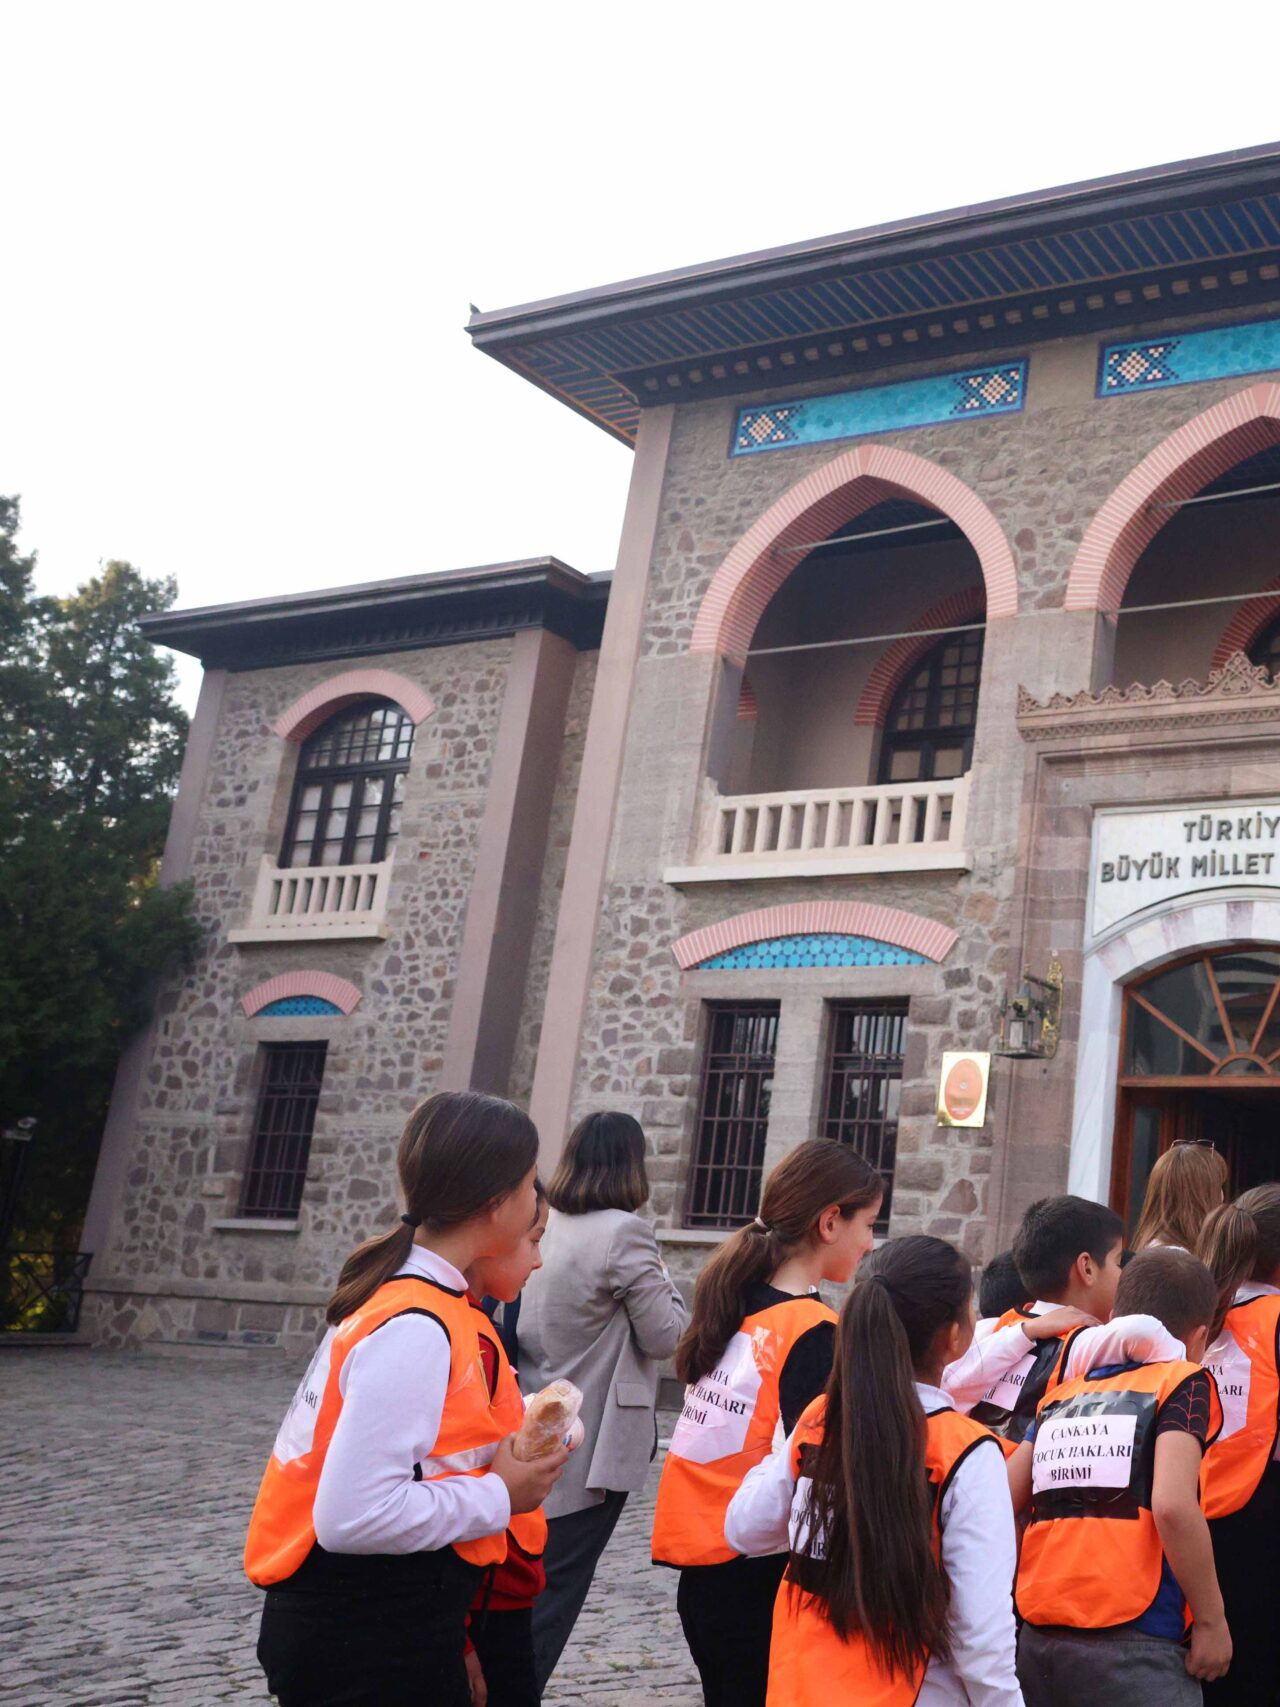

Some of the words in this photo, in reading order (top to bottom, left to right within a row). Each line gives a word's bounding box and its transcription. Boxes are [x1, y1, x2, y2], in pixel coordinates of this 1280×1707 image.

[1100, 853, 1179, 882] BÜYÜK
[1191, 849, 1274, 877] MİLLET
[682, 1403, 708, 1425] İRİMİ
[1051, 1423, 1109, 1441] ÇANKAYA
[1068, 1445, 1132, 1458] HAKLARI
[1050, 1464, 1092, 1481] BİRİMİ
